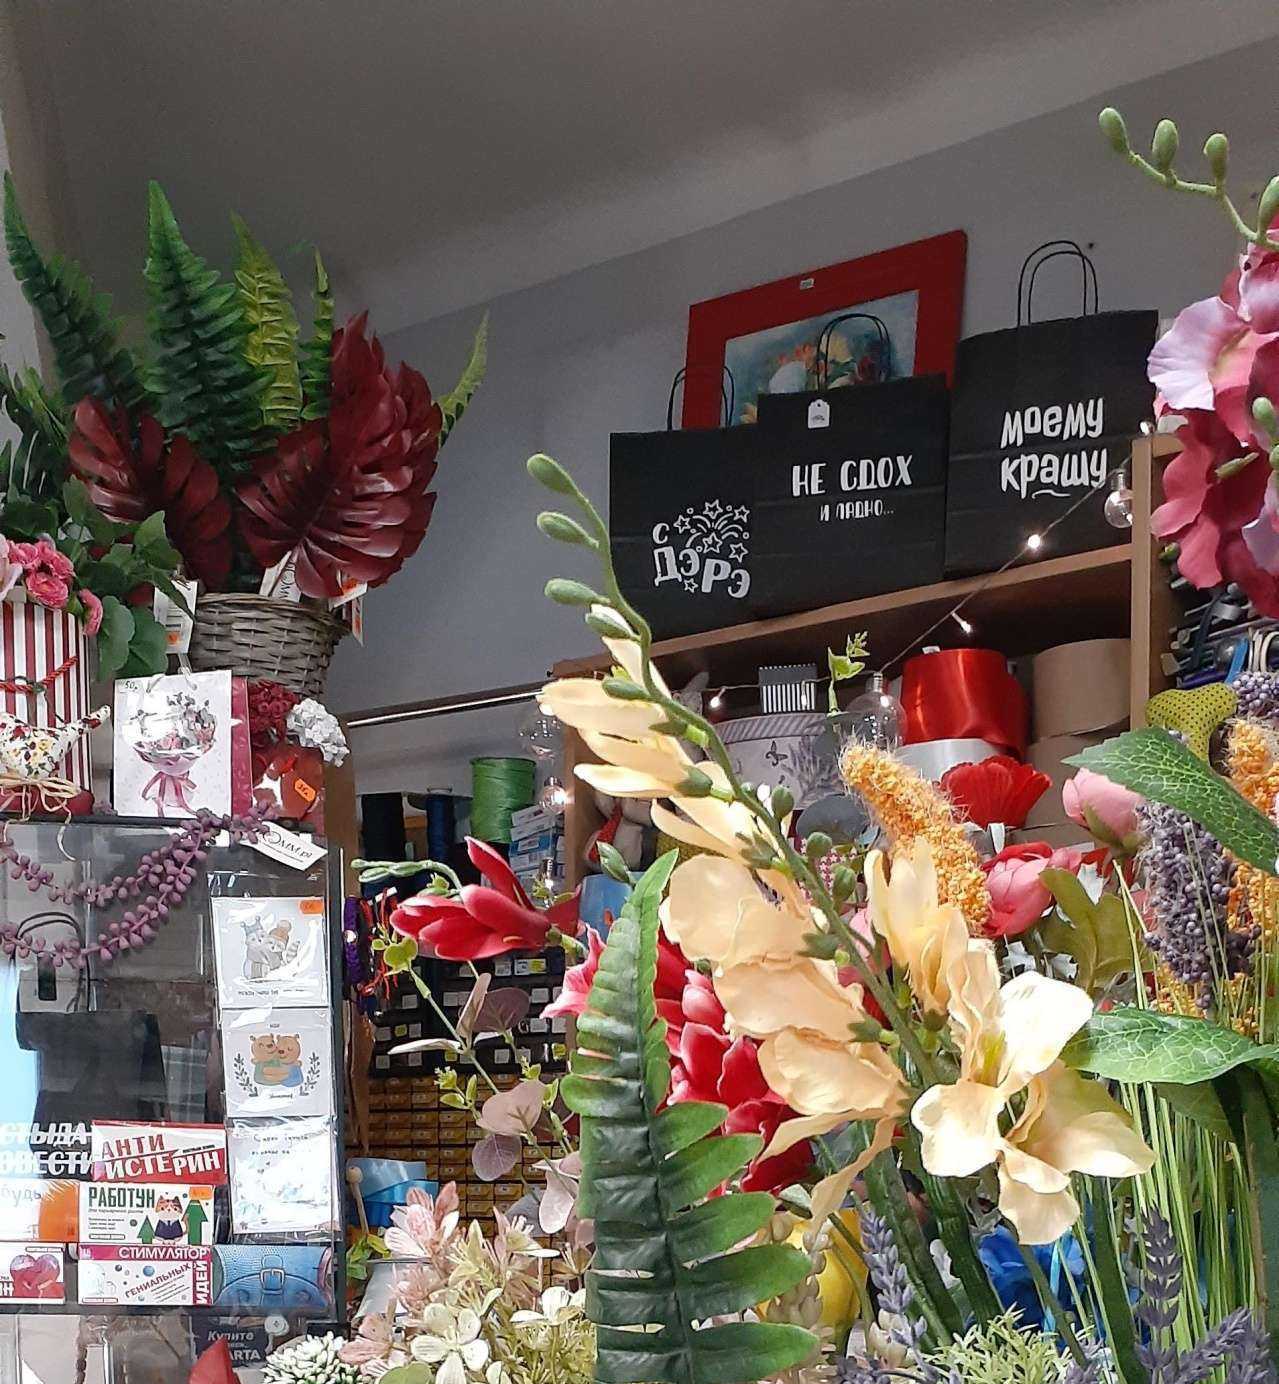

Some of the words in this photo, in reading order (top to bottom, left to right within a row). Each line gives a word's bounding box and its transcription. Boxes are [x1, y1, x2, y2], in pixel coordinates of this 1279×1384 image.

[792, 463, 826, 497] НЕ
[840, 455, 912, 491] СДОХ
[820, 504, 829, 521] И
[653, 546, 751, 598] ДЭРЭ
[102, 1134, 165, 1159] АНТИ
[105, 1151, 221, 1180] ИСТЕРИН
[88, 1186, 155, 1208] РАБОТУН
[119, 1246, 208, 1260] СТИМУЛЯТОР
[125, 1263, 192, 1298] ГЕНИАЛЬНЫХ
[194, 1261, 209, 1305] ИДЕЙ
